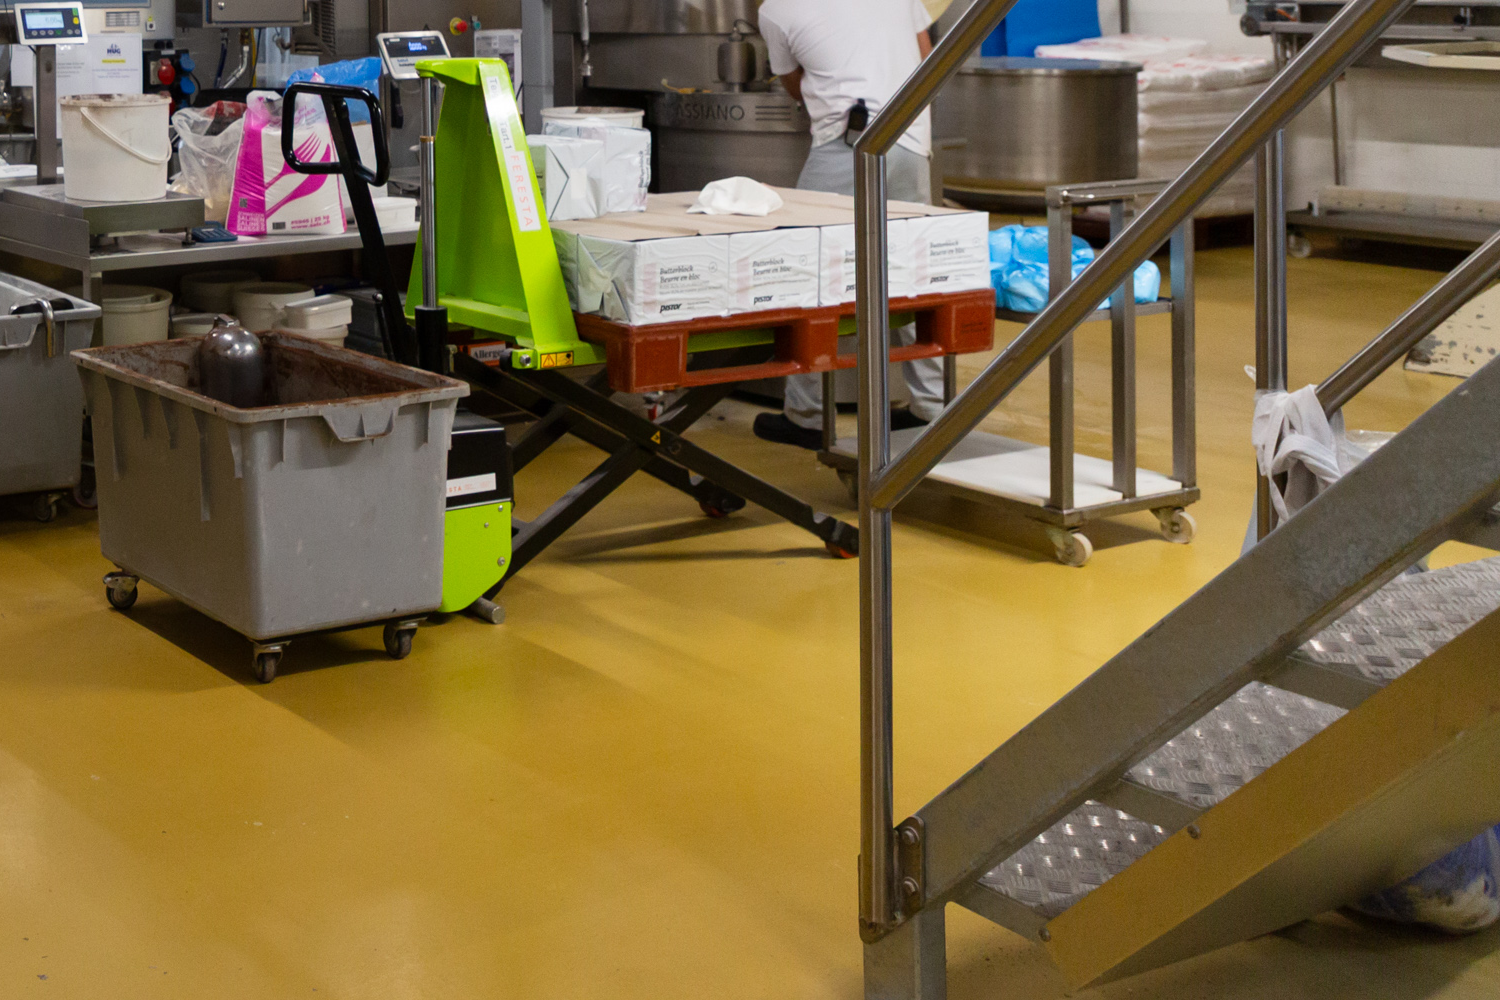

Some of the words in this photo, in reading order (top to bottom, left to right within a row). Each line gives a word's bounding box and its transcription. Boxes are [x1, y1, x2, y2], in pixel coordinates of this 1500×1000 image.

[671, 103, 745, 121] ASSIANO
[510, 155, 534, 227] FERESTA
[659, 265, 694, 275] Butterblock
[660, 274, 679, 284] Beurre
[688, 272, 701, 281] bloc
[753, 295, 774, 305] pistor
[660, 303, 682, 314] pistor
